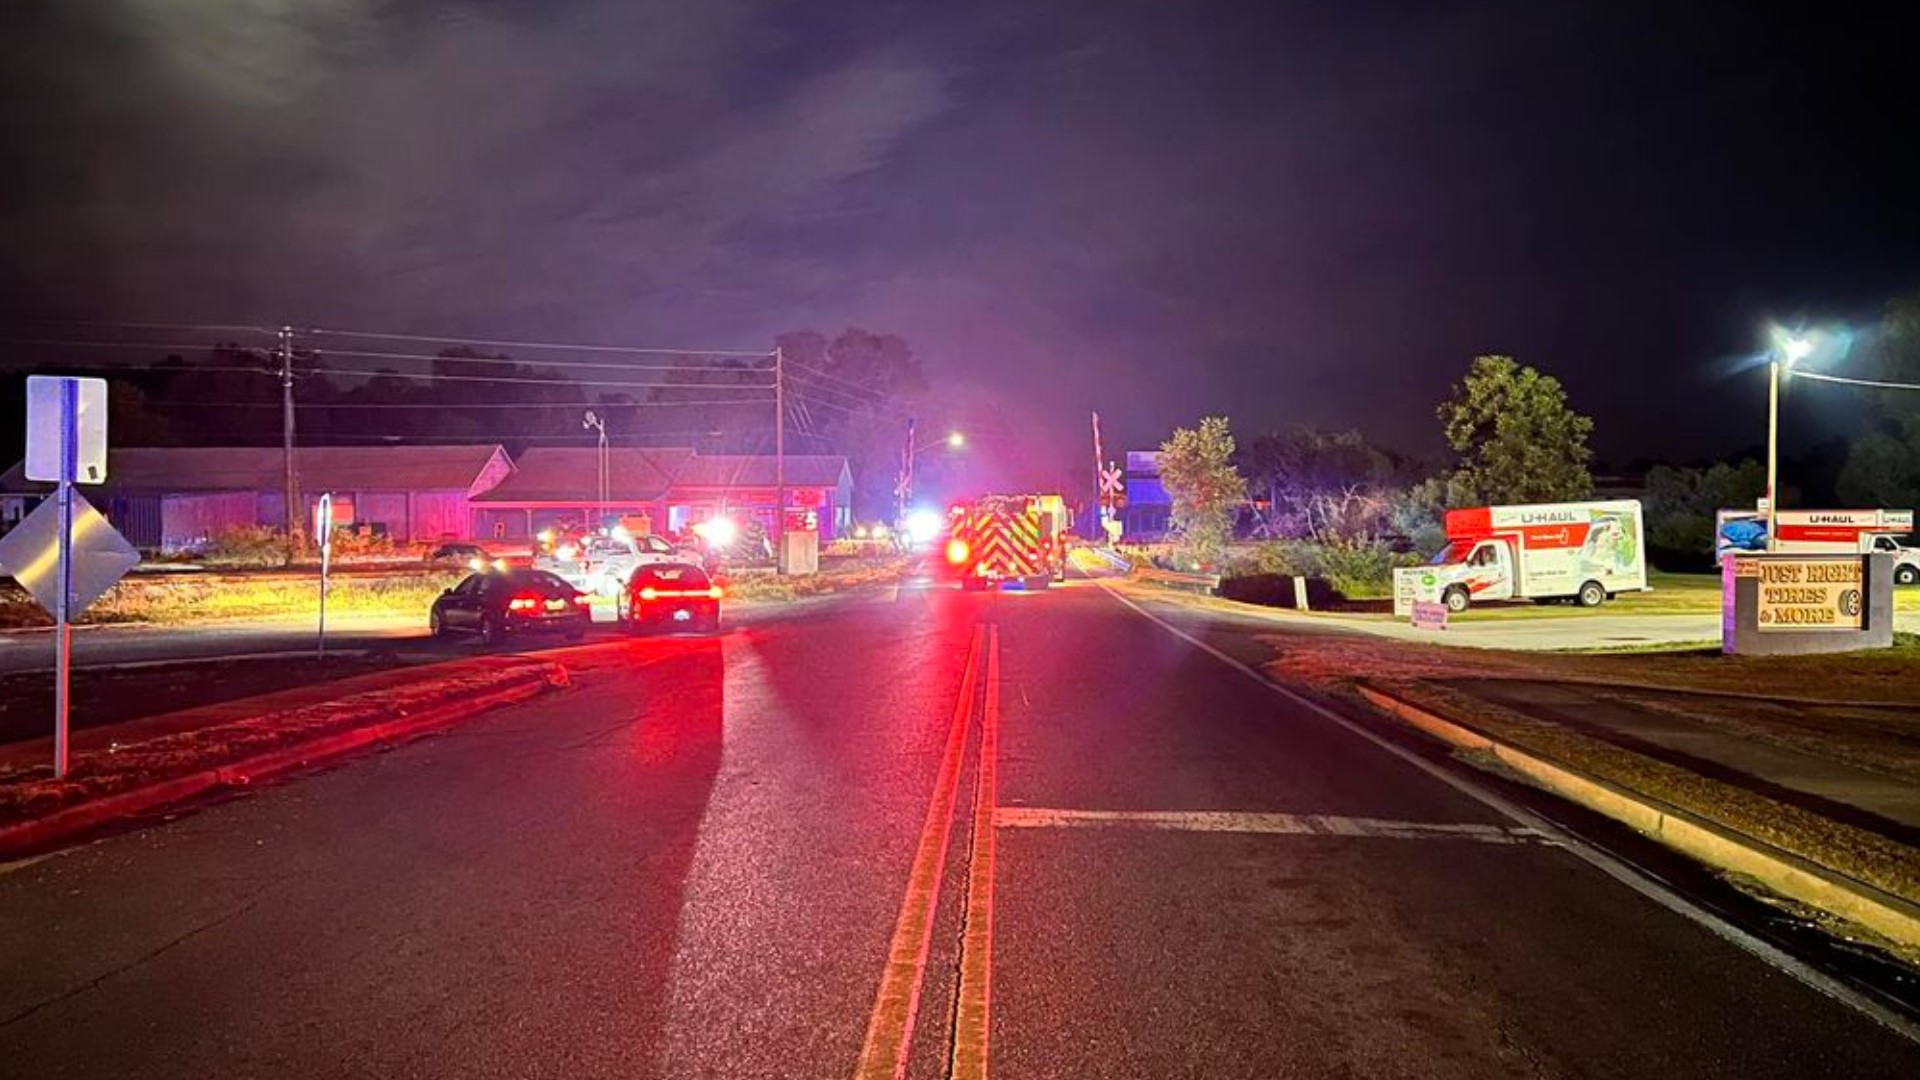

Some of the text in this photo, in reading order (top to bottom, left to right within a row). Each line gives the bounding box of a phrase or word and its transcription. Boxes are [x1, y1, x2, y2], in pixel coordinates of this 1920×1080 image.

[1521, 510, 1577, 524] U-HAUL
[1809, 514, 1855, 524] U-HAUL
[1760, 564, 1803, 583] JUST
[1806, 564, 1862, 583] RIGHT
[1764, 587, 1828, 604] TIRES
[1774, 607, 1835, 624] MORE
